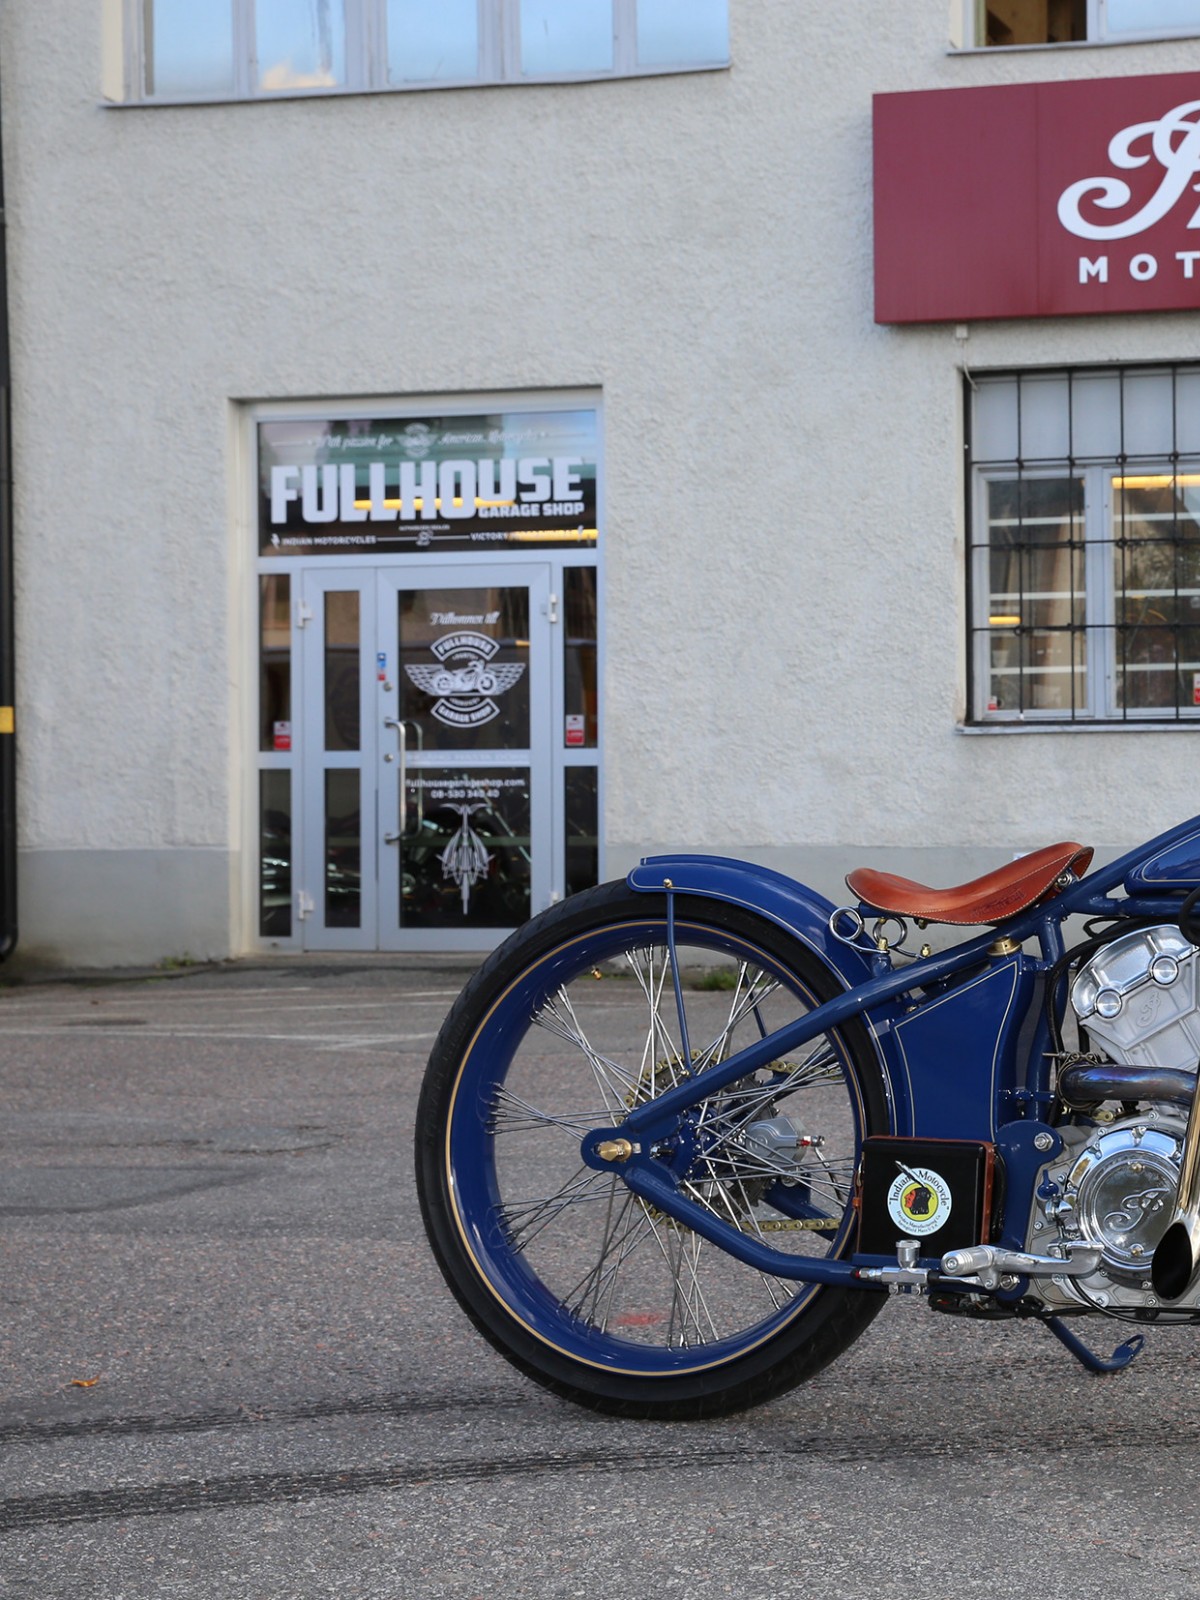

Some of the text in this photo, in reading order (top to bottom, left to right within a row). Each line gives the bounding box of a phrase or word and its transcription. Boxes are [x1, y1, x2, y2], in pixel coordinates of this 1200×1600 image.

[271, 457, 584, 524] FULLHOUSE
[478, 502, 585, 518] GARAGE SHOP
